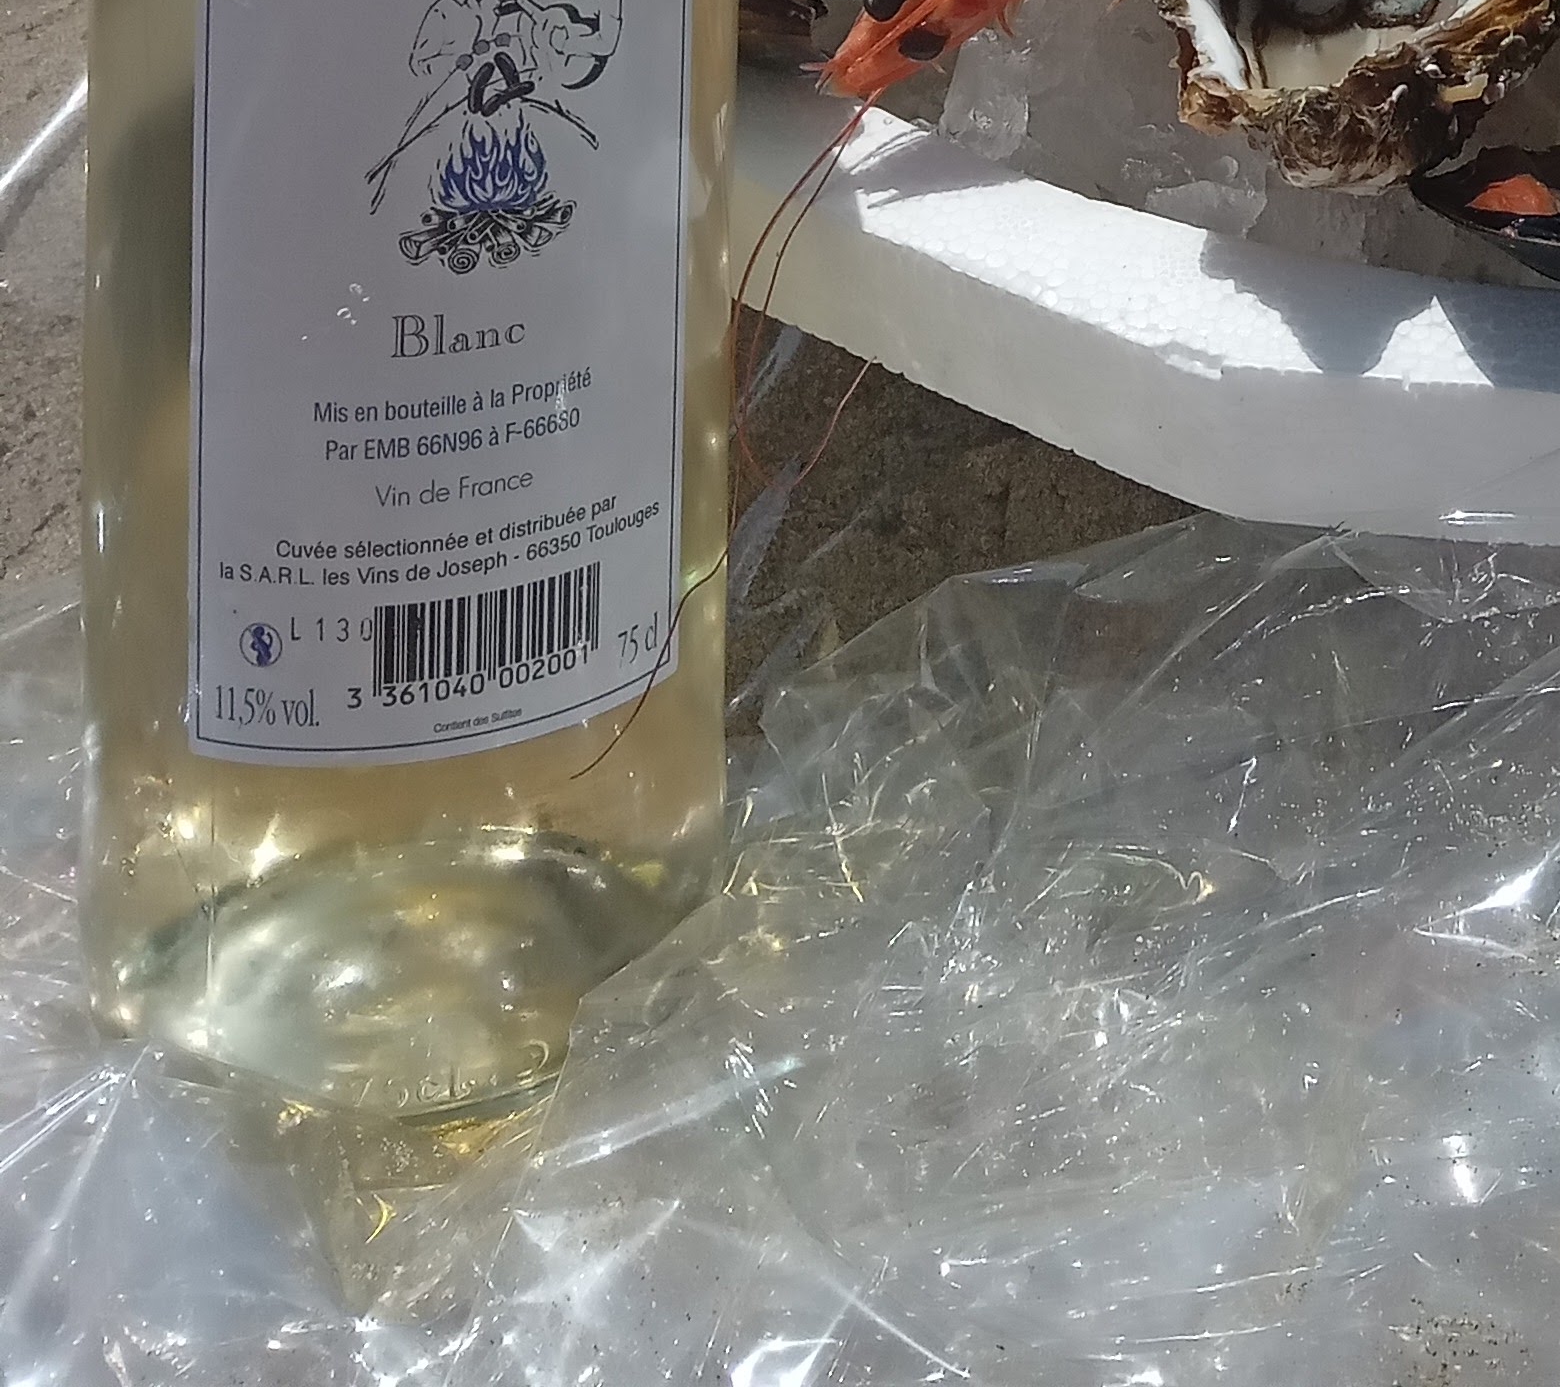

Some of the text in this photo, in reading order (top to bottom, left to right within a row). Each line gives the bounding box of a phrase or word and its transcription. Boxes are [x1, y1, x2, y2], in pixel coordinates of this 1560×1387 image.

[390, 313, 527, 359] Blanc
[313, 366, 592, 423] Mis en bouteille à la Propriété
[325, 439, 358, 461] Par
[364, 437, 411, 460] EMB
[417, 428, 483, 456] 66N96
[488, 425, 500, 447] à
[375, 470, 534, 507] Vin de France
[219, 561, 234, 580] la
[322, 568, 350, 586] les
[357, 566, 400, 585] Vins
[405, 564, 431, 583] de
[436, 550, 508, 578] Joseph
[526, 531, 582, 562] 66350
[586, 501, 661, 543] Toulouges
[275, 495, 618, 559] Cuvée sélectionnée et distribuée par
[617, 610, 658, 664] 75 cl
[215, 684, 320, 729] 11,5% vol.
[347, 688, 362, 709] 3
[382, 673, 485, 707] 361040
